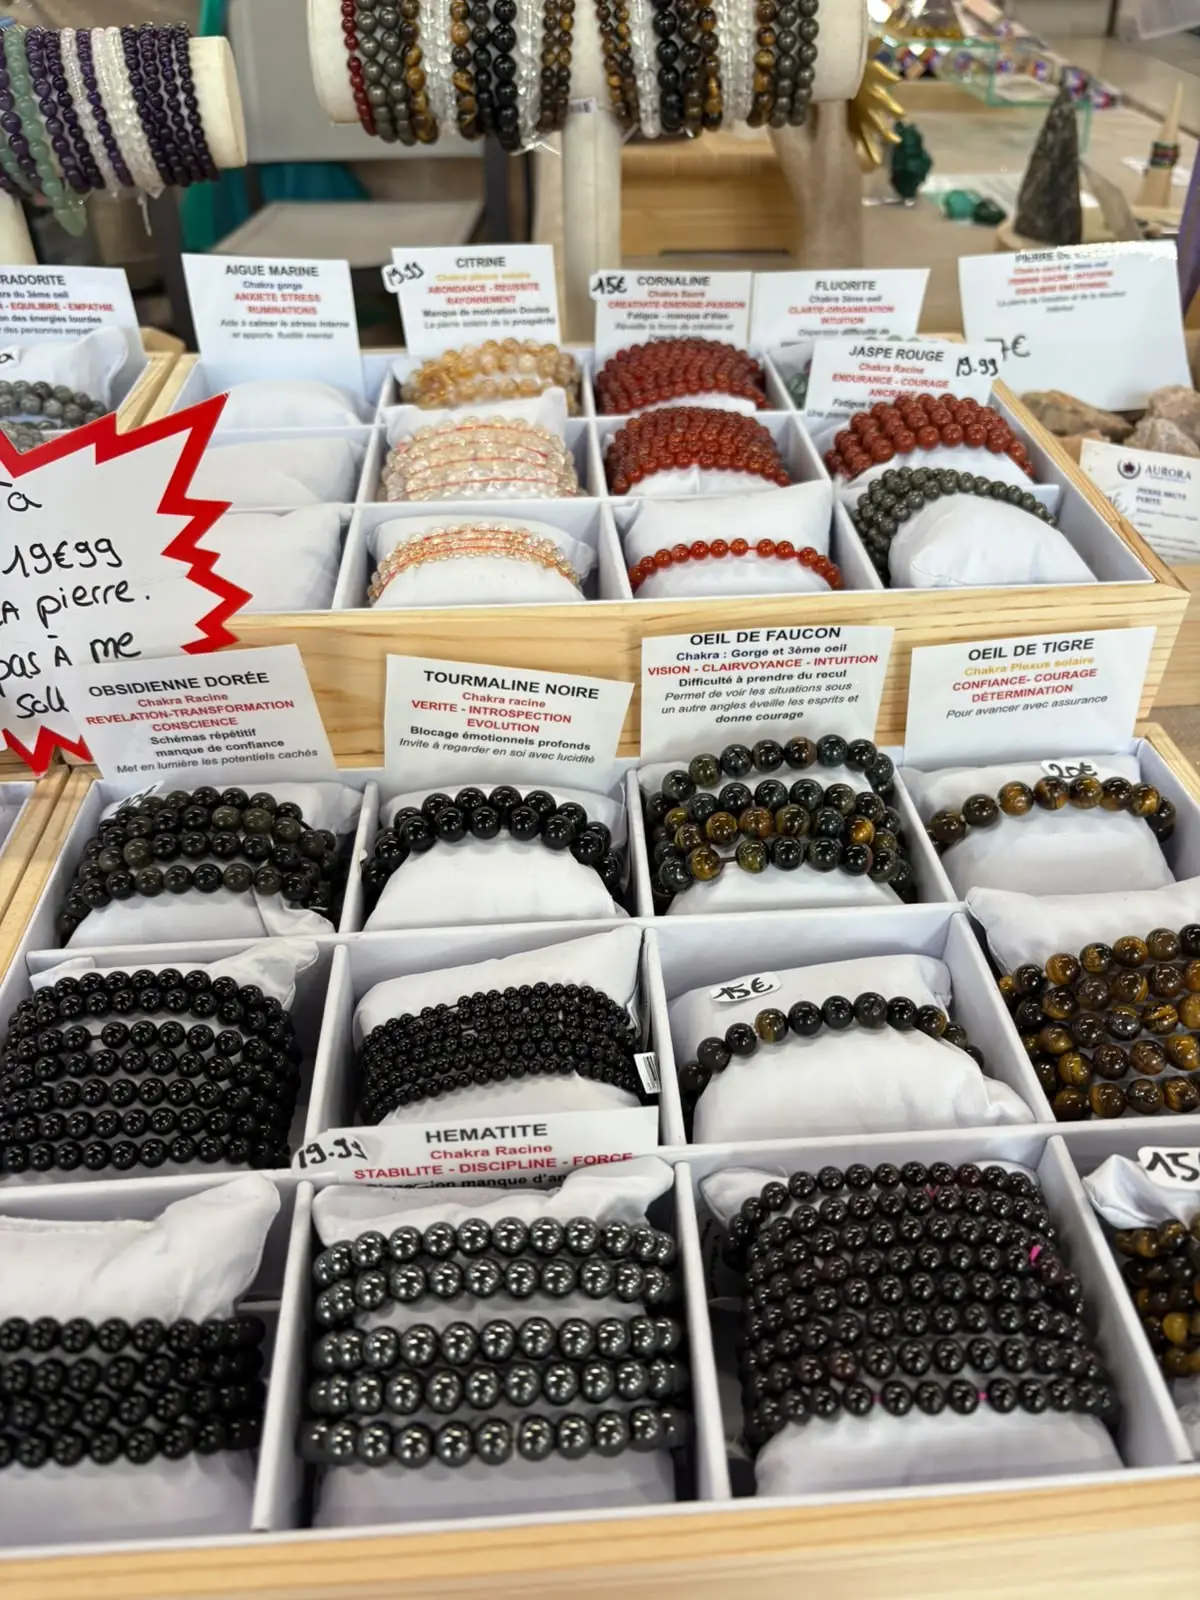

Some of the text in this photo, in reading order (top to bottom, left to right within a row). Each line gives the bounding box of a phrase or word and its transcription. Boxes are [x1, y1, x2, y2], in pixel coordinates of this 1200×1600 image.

[225, 265, 319, 277] AIGUE MARINE
[456, 257, 506, 268] CITRINE
[0, 274, 66, 286] RADORITE
[243, 281, 303, 290] Chakra gorge
[428, 282, 540, 293] ABONDANCE REUSSITE
[592, 276, 627, 294] 15€
[637, 275, 711, 286] CORNALINE
[815, 281, 877, 291] FLUORITE
[281, 293, 321, 302] STRESS
[446, 296, 516, 305] RAYONNEMENT
[809, 295, 840, 303] Chakra
[10, 302, 61, 311] EQUILIBRE
[68, 303, 114, 312] EMPATHIE
[246, 305, 317, 315] RUMINATIONS
[422, 306, 549, 318] Manque de motivation Doutes
[627, 312, 659, 320] Fatigue
[820, 317, 865, 325] INTUITION
[849, 345, 944, 362] JASPE ROUGE
[858, 363, 925, 374] Chakra Racine
[832, 373, 949, 389] ENDURANCE COURAGE
[832, 398, 866, 409] Fatigue
[1145, 464, 1192, 480] AURORA
[2, 537, 123, 577] 19€99
[0, 600, 19, 625] A
[690, 627, 841, 646] OEIL DE FAUCON
[90, 632, 142, 663] me
[676, 643, 847, 662] Chakra Gorge et 3ème oeil
[968, 638, 1095, 661] OEIL DE TIGRE
[648, 655, 879, 677] VISION CLAIRVOYANCE INTUITION
[964, 656, 1095, 677] Chakra Plexus solaire
[88, 671, 270, 697] OBSIDIENNE DORÉE
[423, 670, 600, 700] TOURMALINE NOIRE
[679, 669, 847, 688] Difficulté à prendre du recul
[952, 668, 1098, 692] CONFIANCE- COURAGE
[137, 692, 229, 708] Chakra Racine
[462, 691, 546, 709] Chakra racine
[665, 681, 852, 702] Permet de voir les situations sous
[85, 700, 295, 726] REVELATION-TRANSFORMATION
[412, 700, 572, 724] VERITE INTROSPECTION
[661, 694, 859, 715] un autre angles éveille les esprits et
[946, 695, 1108, 719] Pour avancer avec assurance
[152, 717, 239, 732] CONSCIENCE
[466, 718, 541, 734] EVOLUTION
[715, 710, 804, 724] donne courage
[150, 728, 257, 746] Schémas répétitif
[410, 725, 591, 752] Blocage émotionnels profonds
[155, 739, 285, 760] manque de confiance
[399, 738, 595, 765] Invite à regarder en soi avec lucidité
[117, 748, 318, 774] Met en lumière les potentiels cachés
[713, 977, 774, 1000] 15€
[425, 1123, 549, 1144] HEMATITE
[430, 1143, 553, 1161] Chakra Racine
[354, 1165, 444, 1180] STABILITE
[459, 1157, 557, 1174] DISCIPLINE
[1146, 1152, 1200, 1182] 15
[461, 1176, 527, 1189] manque
